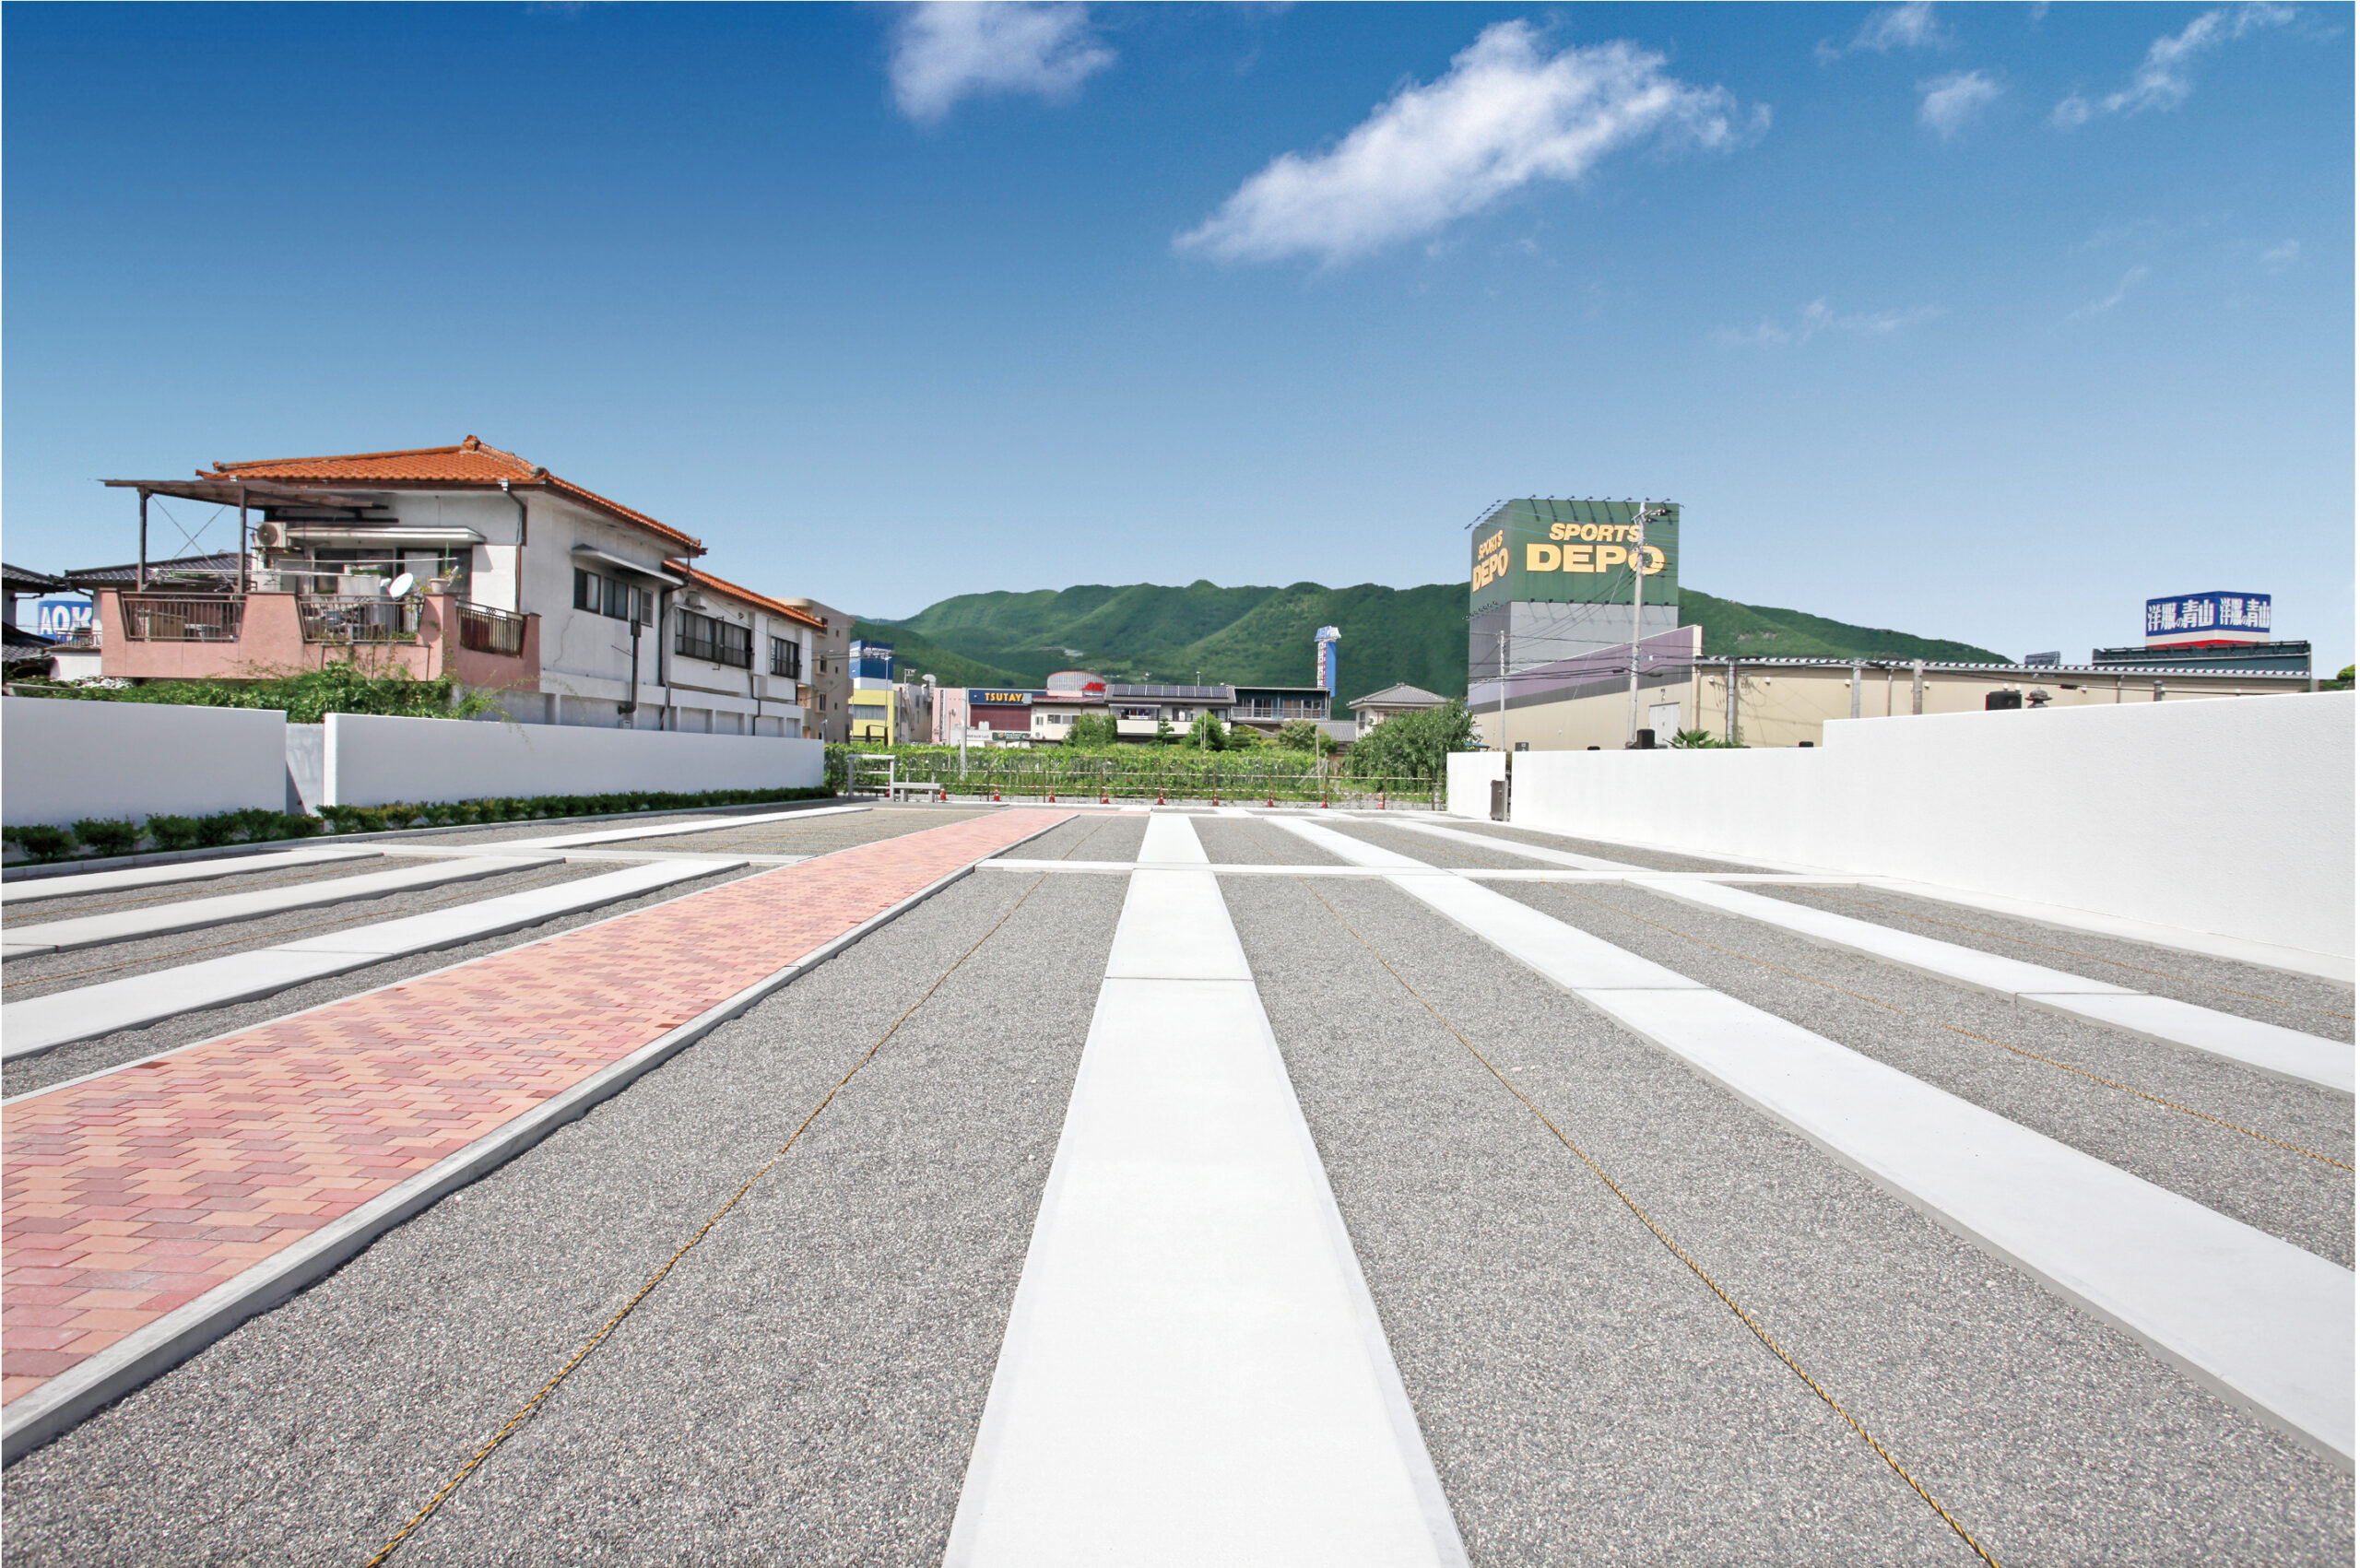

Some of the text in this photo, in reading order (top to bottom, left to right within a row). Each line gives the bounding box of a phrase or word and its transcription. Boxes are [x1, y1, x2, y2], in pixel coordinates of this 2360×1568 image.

[1478, 529, 1504, 560] SPORTS
[1549, 522, 1641, 542] SPORTS
[1472, 547, 1510, 593] DEPO
[1526, 543, 1666, 575] DEPO
[2147, 599, 2214, 632] 洋服の青山
[2219, 597, 2271, 629] 洋服の青山
[985, 692, 1023, 702] TSUTAY
